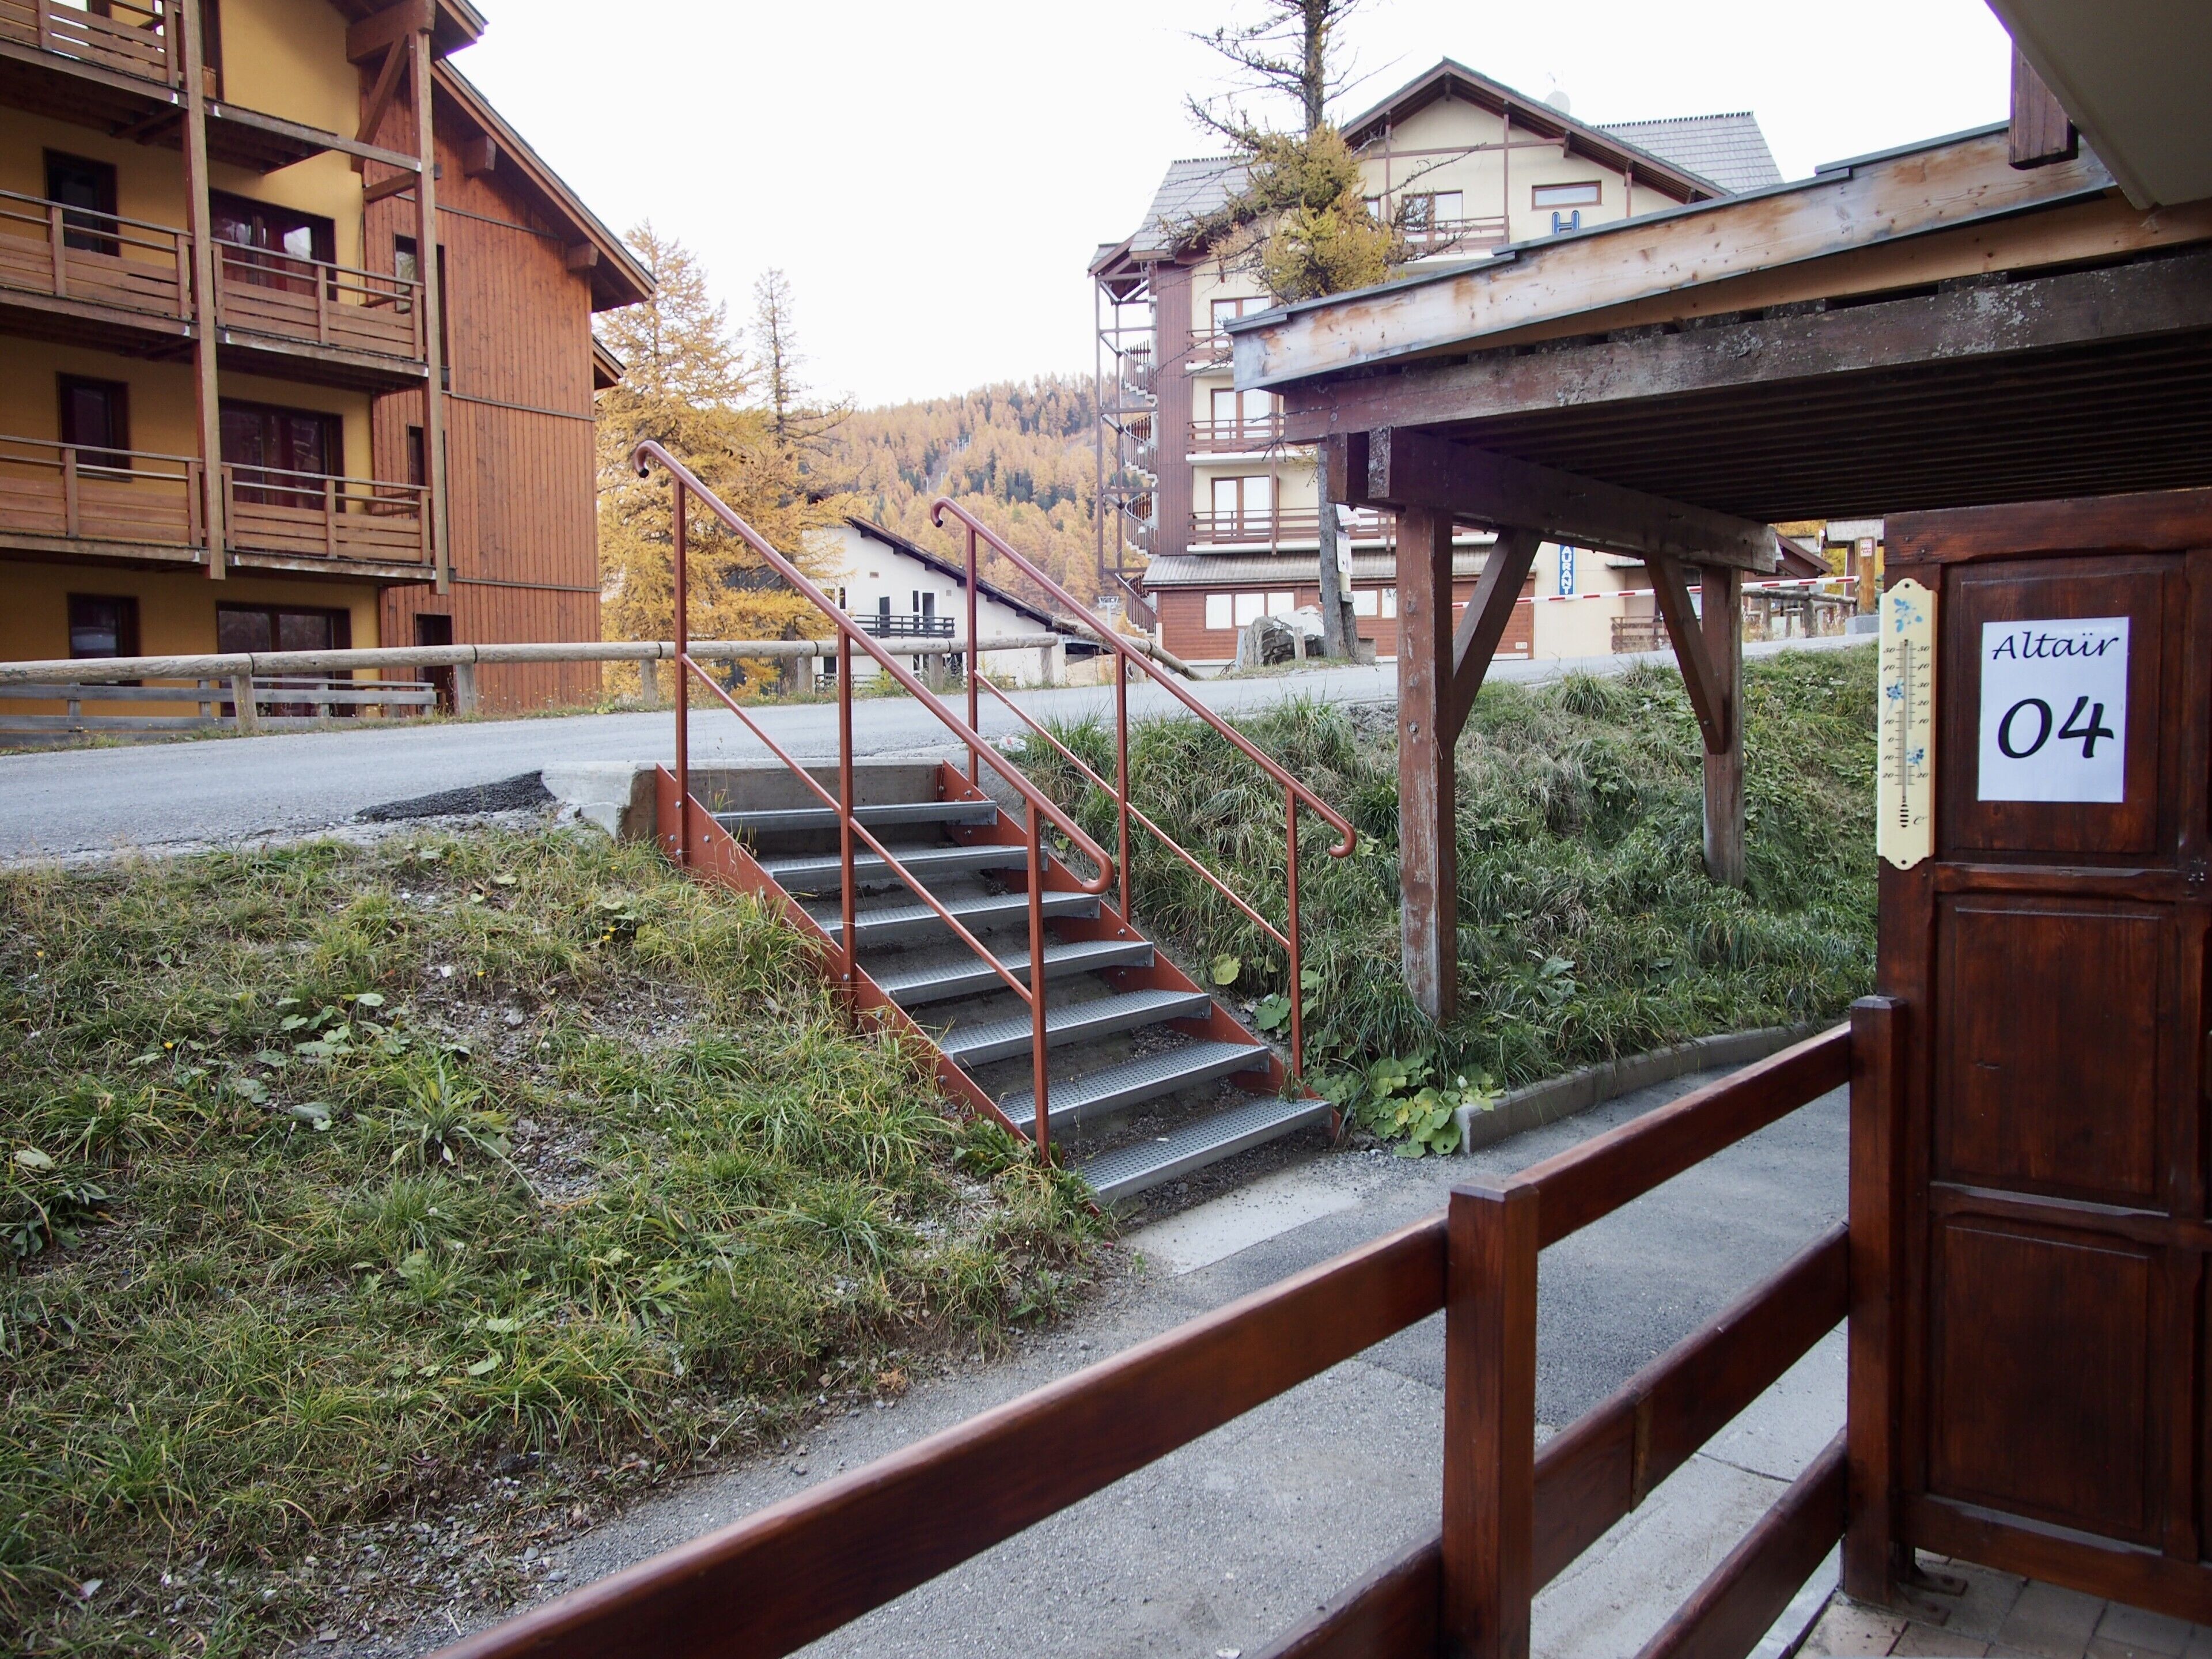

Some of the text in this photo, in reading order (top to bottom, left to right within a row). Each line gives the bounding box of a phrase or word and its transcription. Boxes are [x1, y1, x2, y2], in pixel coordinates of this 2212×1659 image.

[1561, 546, 1572, 594] AURANT
[1992, 631, 2119, 660] Altaïr
[1998, 696, 2114, 759] 04
